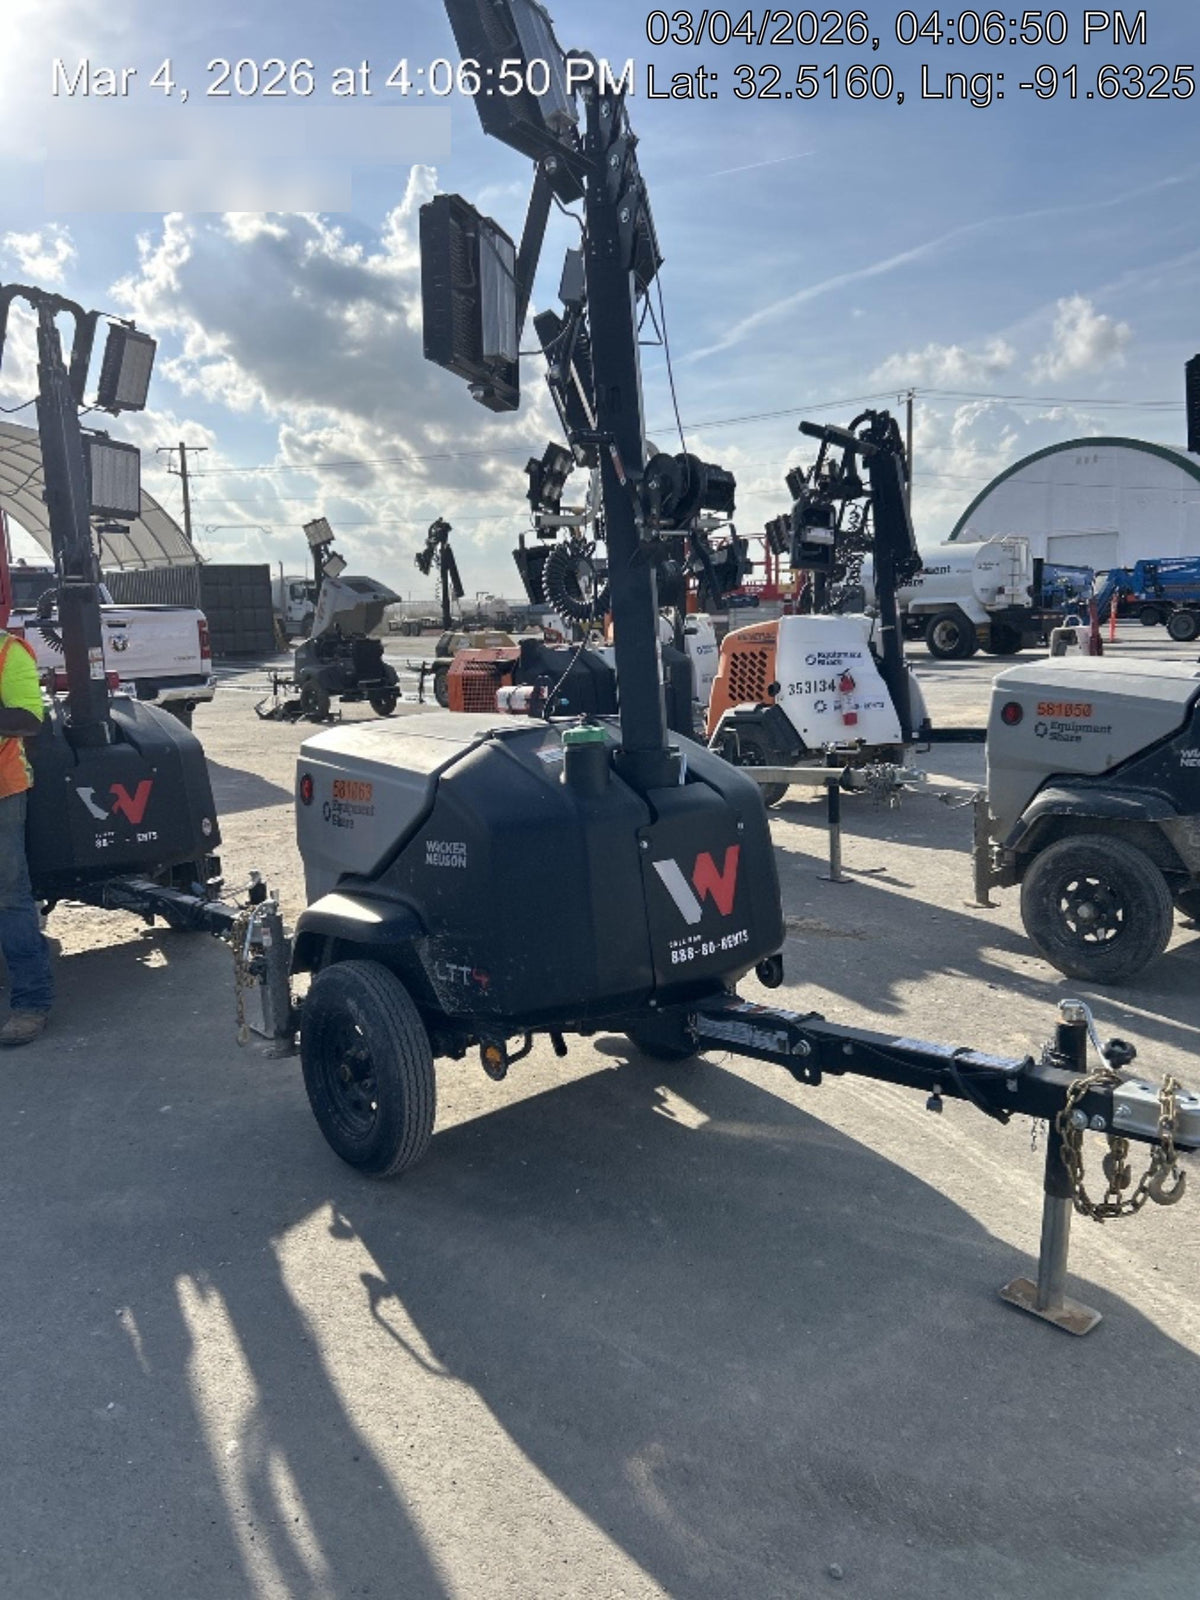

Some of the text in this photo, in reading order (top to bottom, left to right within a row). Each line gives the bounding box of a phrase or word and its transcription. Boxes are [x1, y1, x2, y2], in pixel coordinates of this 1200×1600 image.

[787, 679, 837, 695] 353134
[1037, 702, 1093, 717] 581050
[1050, 721, 1112, 735] Equipment
[426, 840, 467, 855] WACKER
[425, 853, 467, 868] NEUSON
[671, 929, 749, 964] 888-80-RENTS
